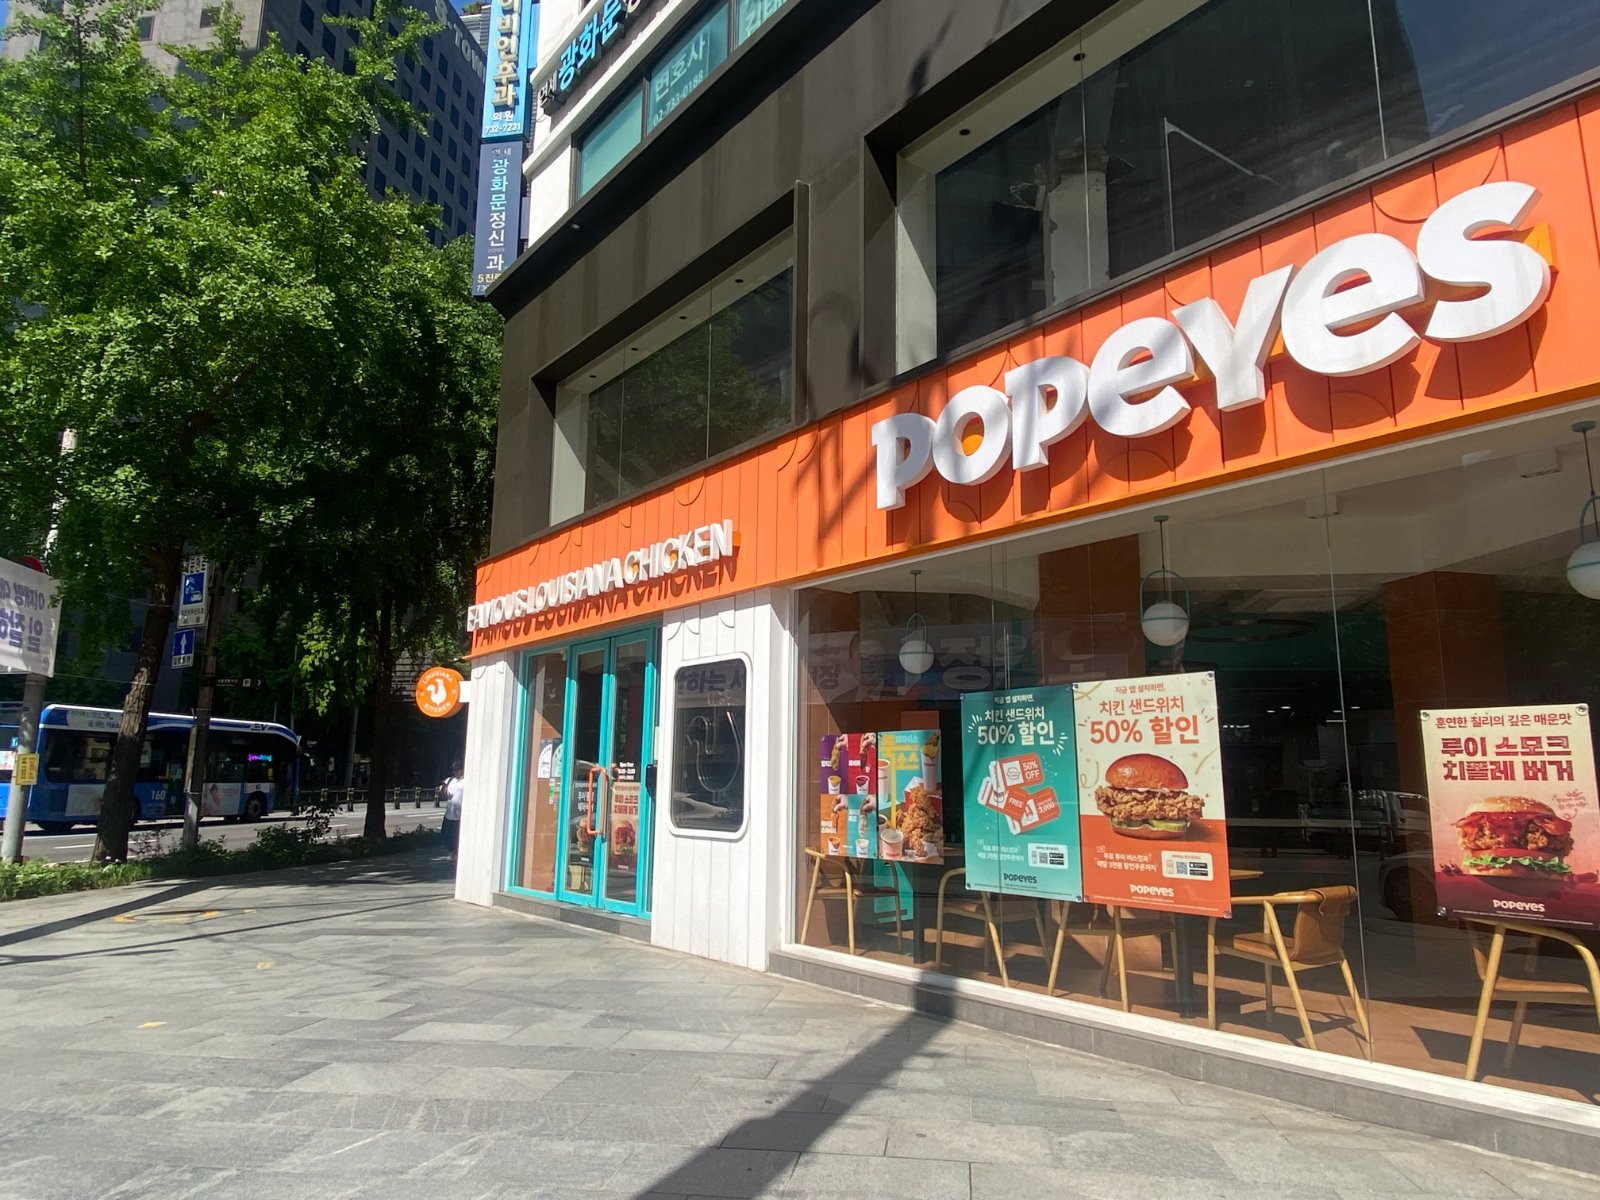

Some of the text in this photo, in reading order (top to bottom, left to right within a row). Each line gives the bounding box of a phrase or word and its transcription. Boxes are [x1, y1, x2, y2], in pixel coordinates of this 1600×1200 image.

[655, 31, 705, 103] 변호사
[492, 110, 514, 122] 의원
[484, 122, 520, 133] 732-7231
[466, 518, 733, 632] FAMOUS LOUISIANA CHICKEN
[422, 670, 453, 685] LOUISIANA
[1128, 685, 1136, 694] 앱
[424, 701, 451, 713] KITCHEN
[1100, 696, 1185, 716] 치킨 샌드위치
[985, 706, 1045, 723] 치킨 샌드위치
[1435, 713, 1572, 729] 훈연한 칠리의 깊은 매운맛
[977, 720, 1054, 746] 50% 할인
[1090, 719, 1143, 744] 50%
[1149, 715, 1200, 745] 할인
[1441, 735, 1572, 757] 루이 스모크
[1022, 760, 1039, 771] 50%
[1442, 760, 1575, 781] 치폴레 버거
[1025, 769, 1040, 780] OFF
[151, 790, 166, 801] 160
[1008, 797, 1025, 809] FREE
[1037, 801, 1055, 814] 3,000
